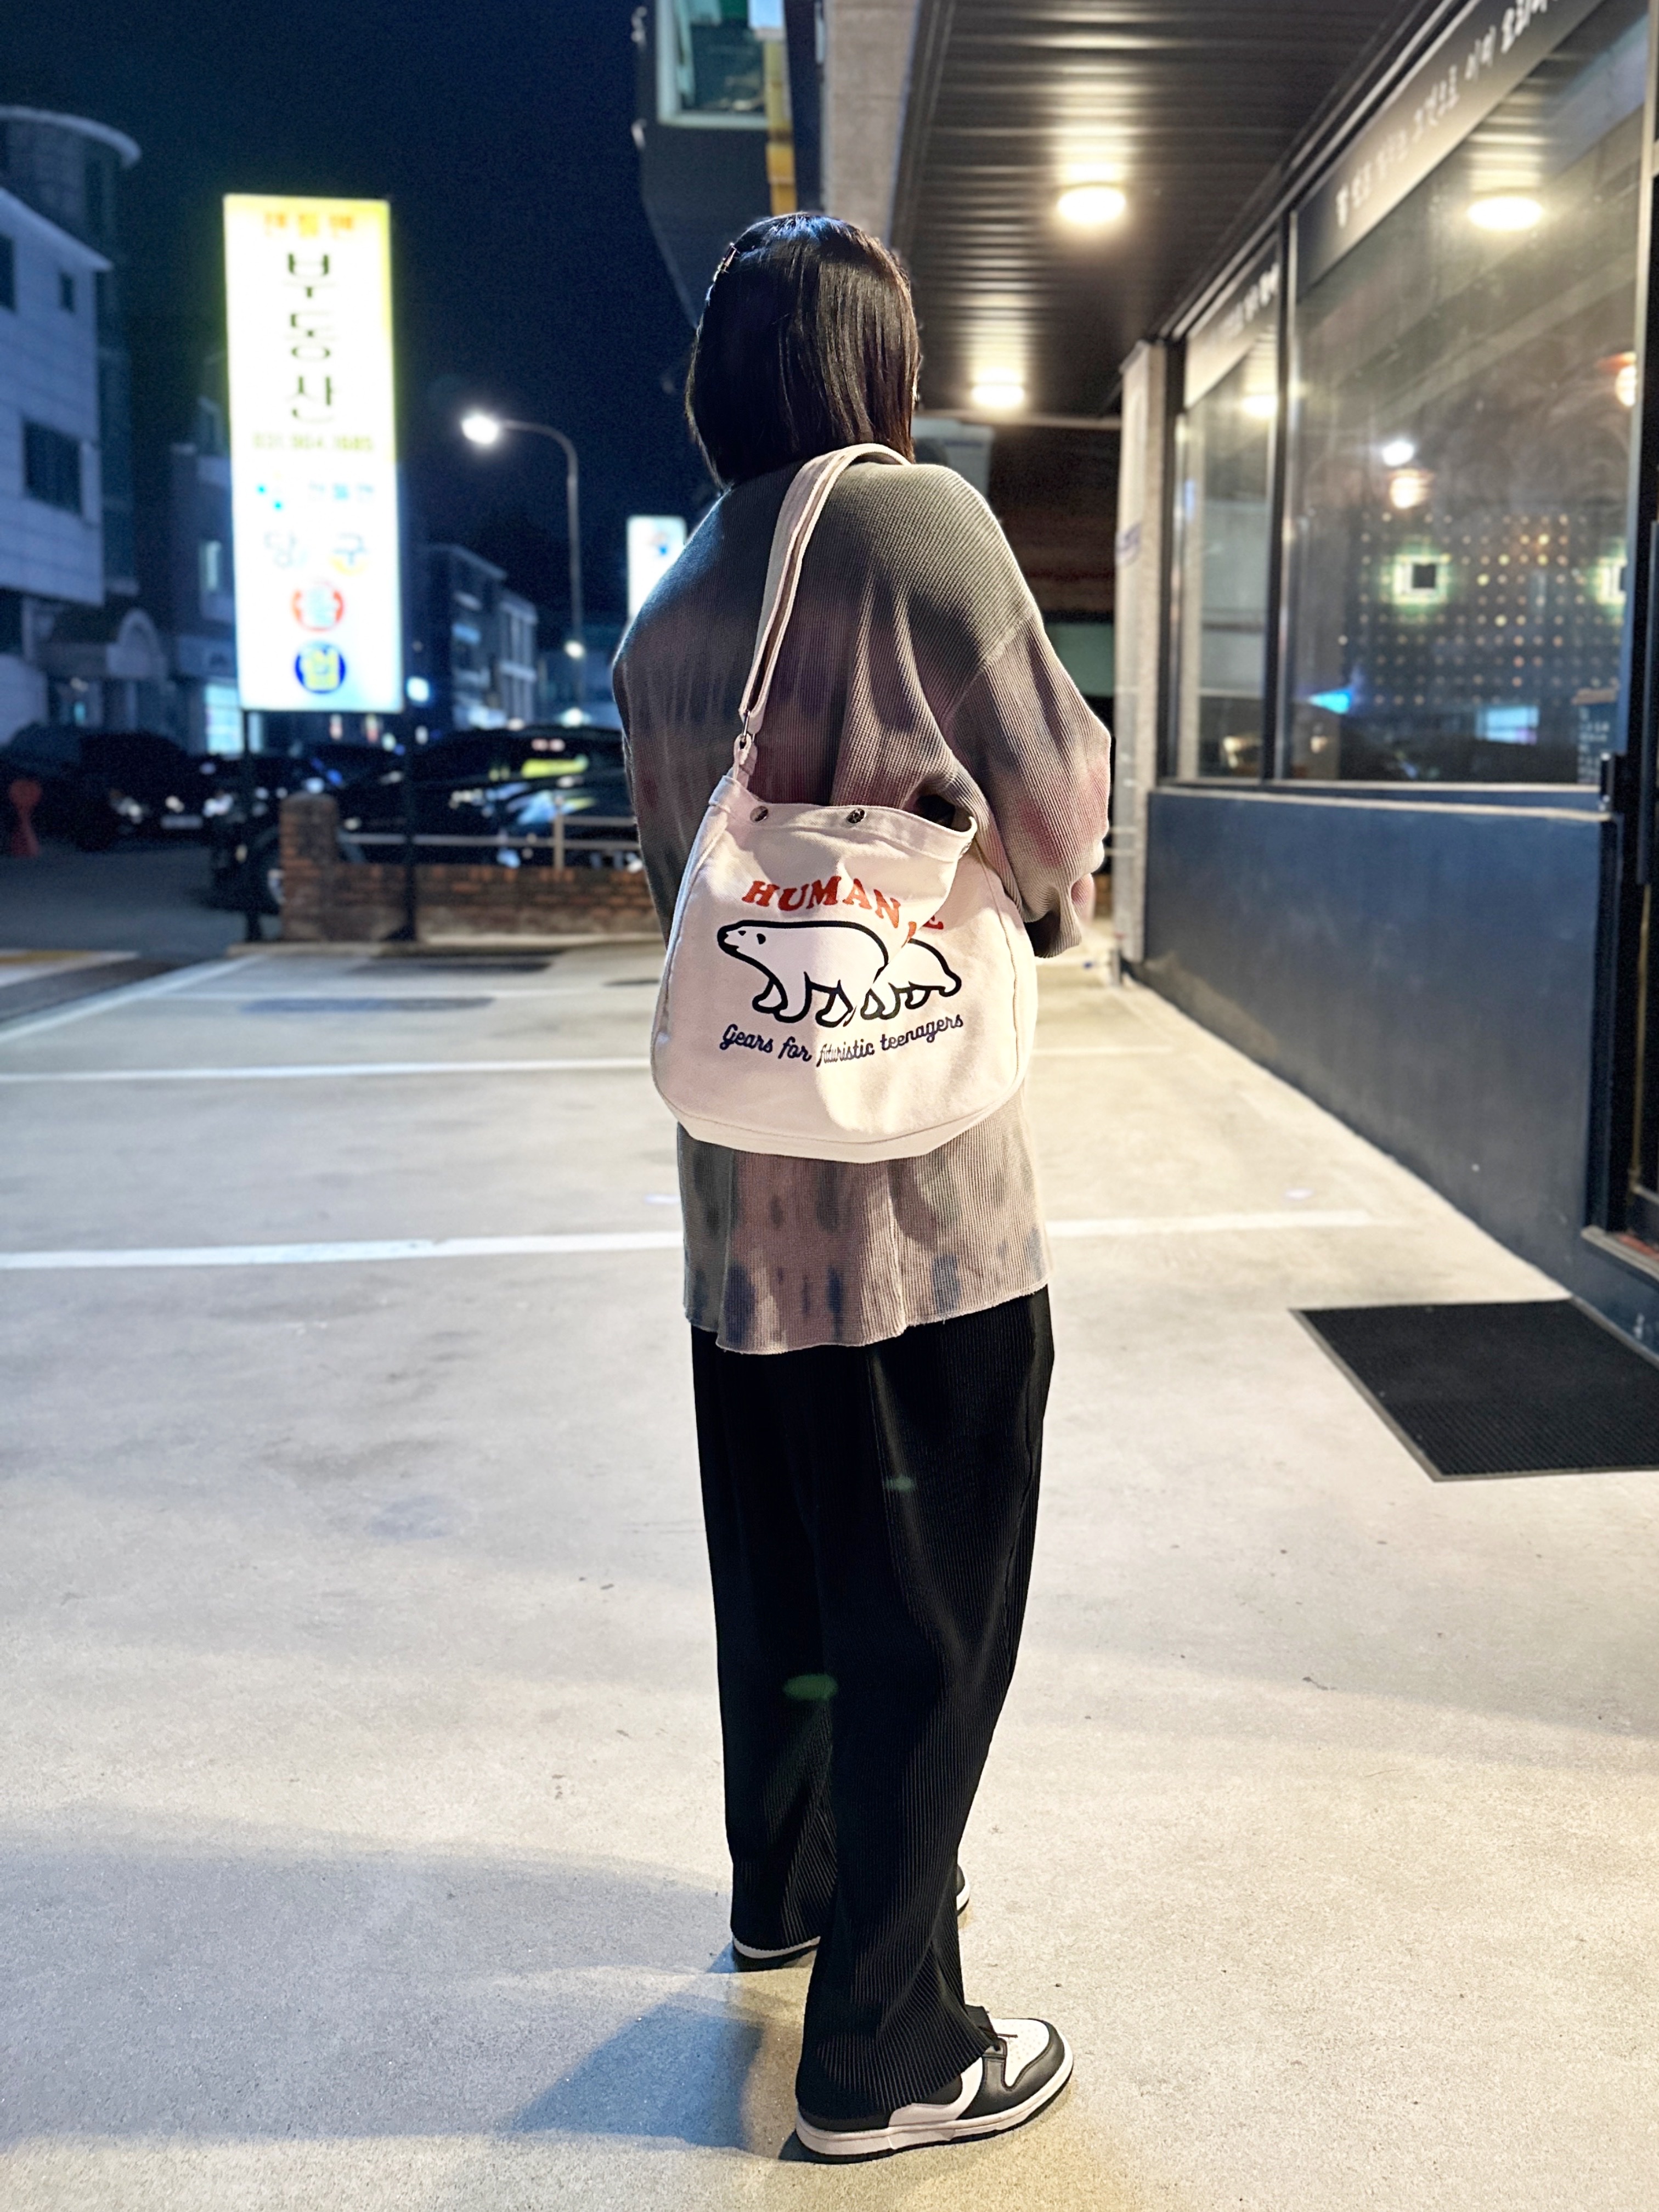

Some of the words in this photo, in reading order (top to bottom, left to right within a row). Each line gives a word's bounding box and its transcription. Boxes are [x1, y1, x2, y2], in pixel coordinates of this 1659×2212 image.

[283, 251, 339, 424] 부동산
[742, 876, 901, 928] HUMAN
[720, 1024, 774, 1053] Gears
[777, 1036, 812, 1062] for
[816, 1039, 875, 1068] futuristic
[880, 1014, 964, 1048] teenagers
